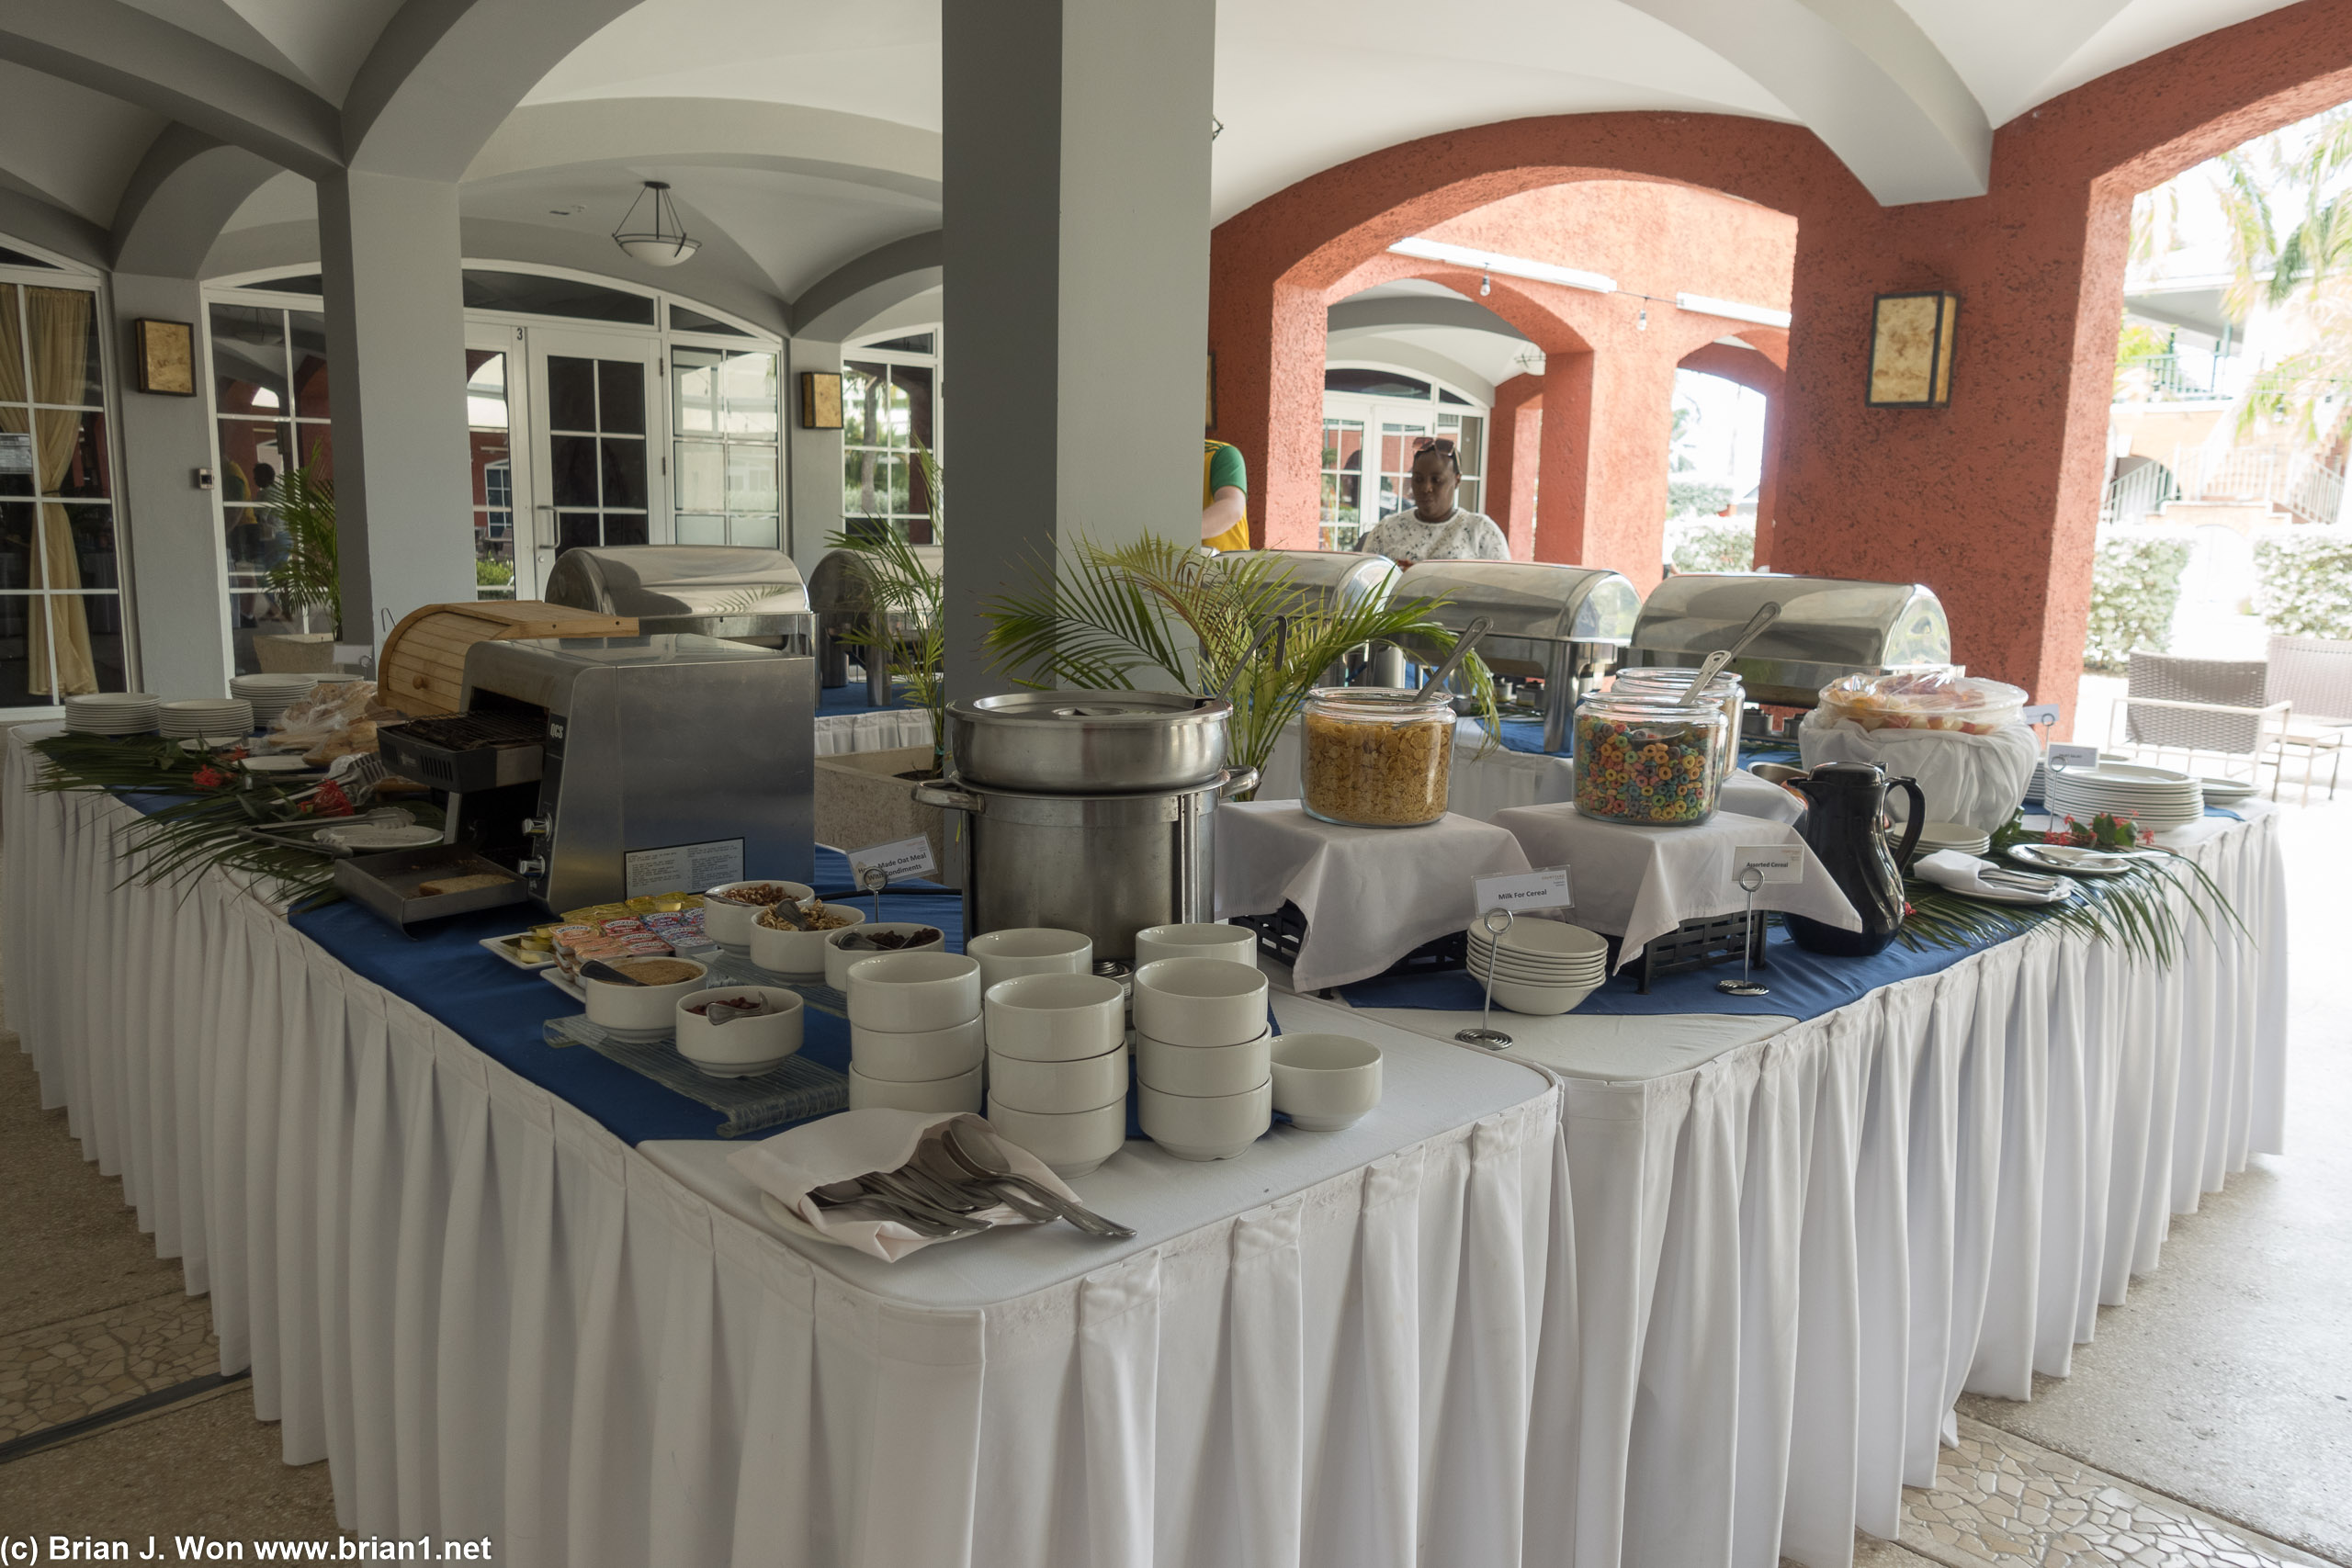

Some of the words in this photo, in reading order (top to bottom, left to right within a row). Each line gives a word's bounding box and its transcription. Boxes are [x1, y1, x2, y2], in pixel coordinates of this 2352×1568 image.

[516, 327, 523, 341] 3
[550, 723, 564, 739] QCS
[877, 860, 896, 869] Made
[910, 852, 927, 862] Meal
[1498, 892, 1513, 900] Milk
[1526, 889, 1547, 897] Cereal
